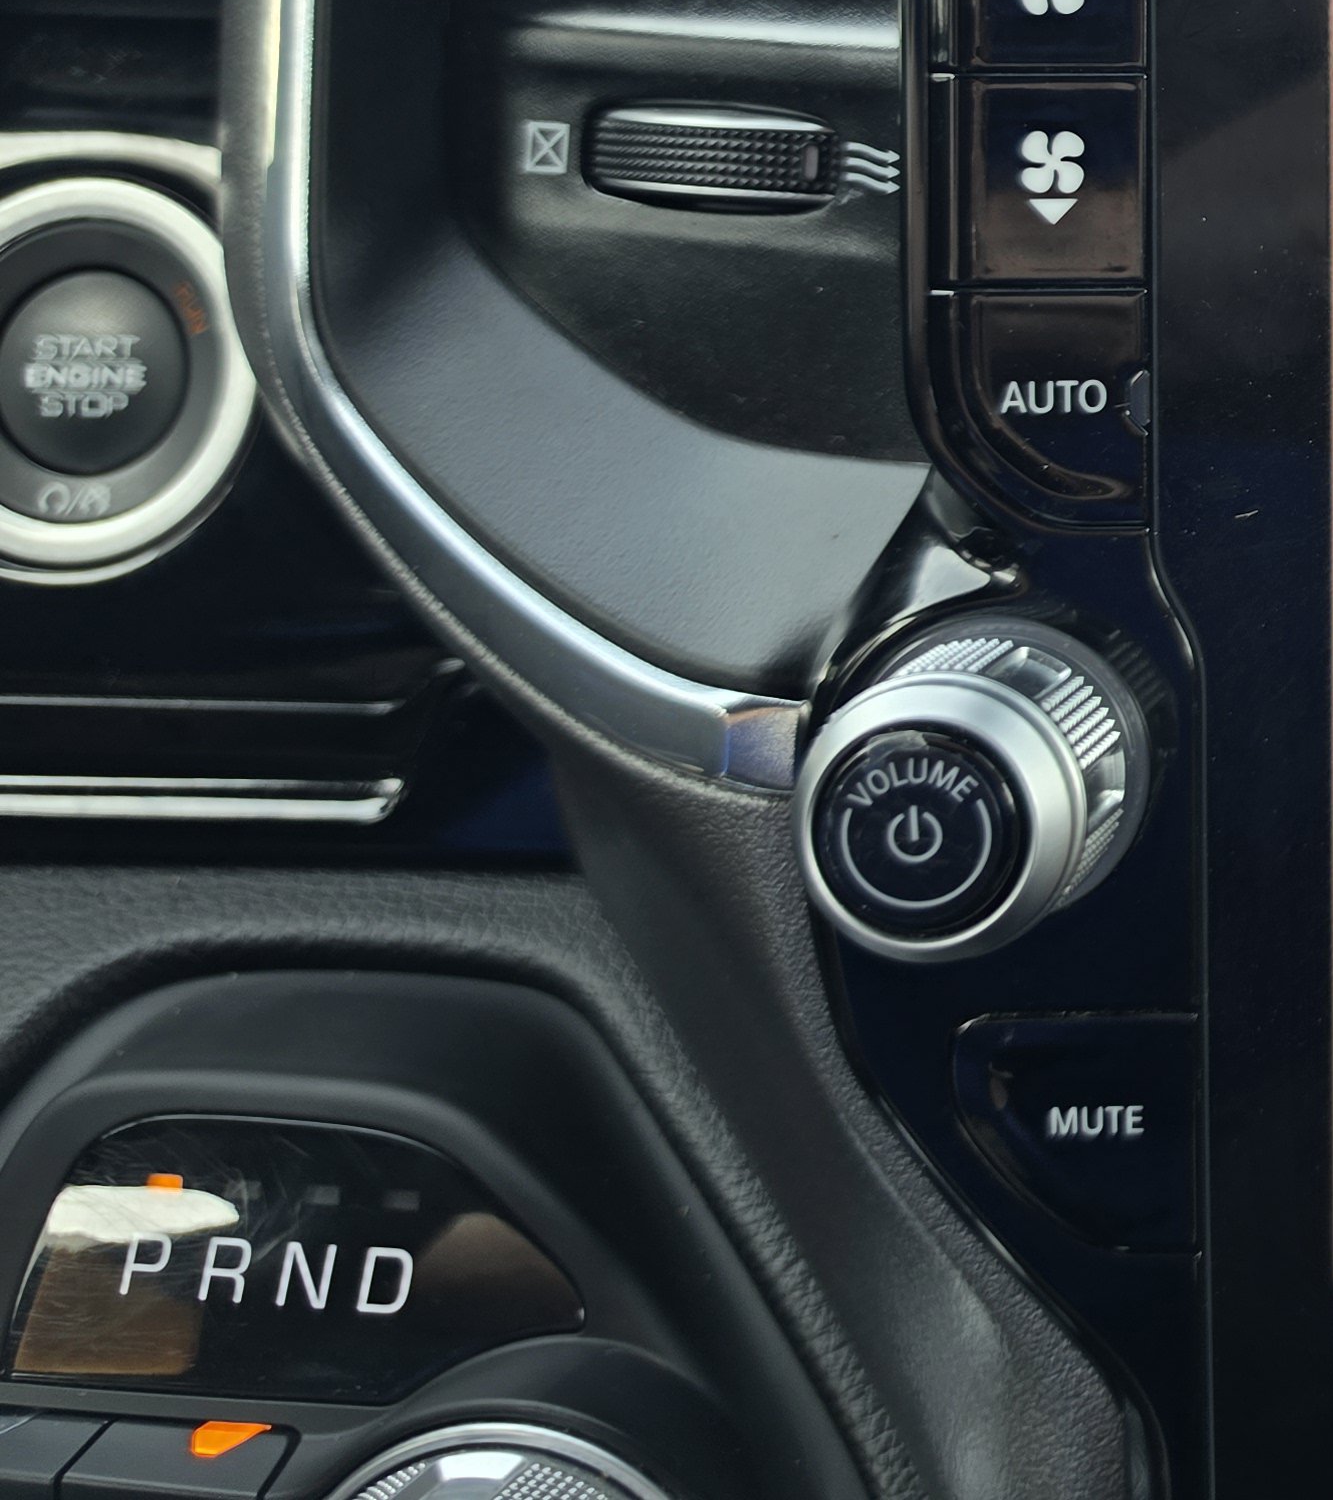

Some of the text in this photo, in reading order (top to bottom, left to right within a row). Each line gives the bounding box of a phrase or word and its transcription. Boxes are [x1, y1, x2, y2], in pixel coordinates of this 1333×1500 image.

[1001, 379, 1108, 414] AUTO
[846, 757, 979, 808] VOLUME
[1047, 1104, 1145, 1137] MUTE
